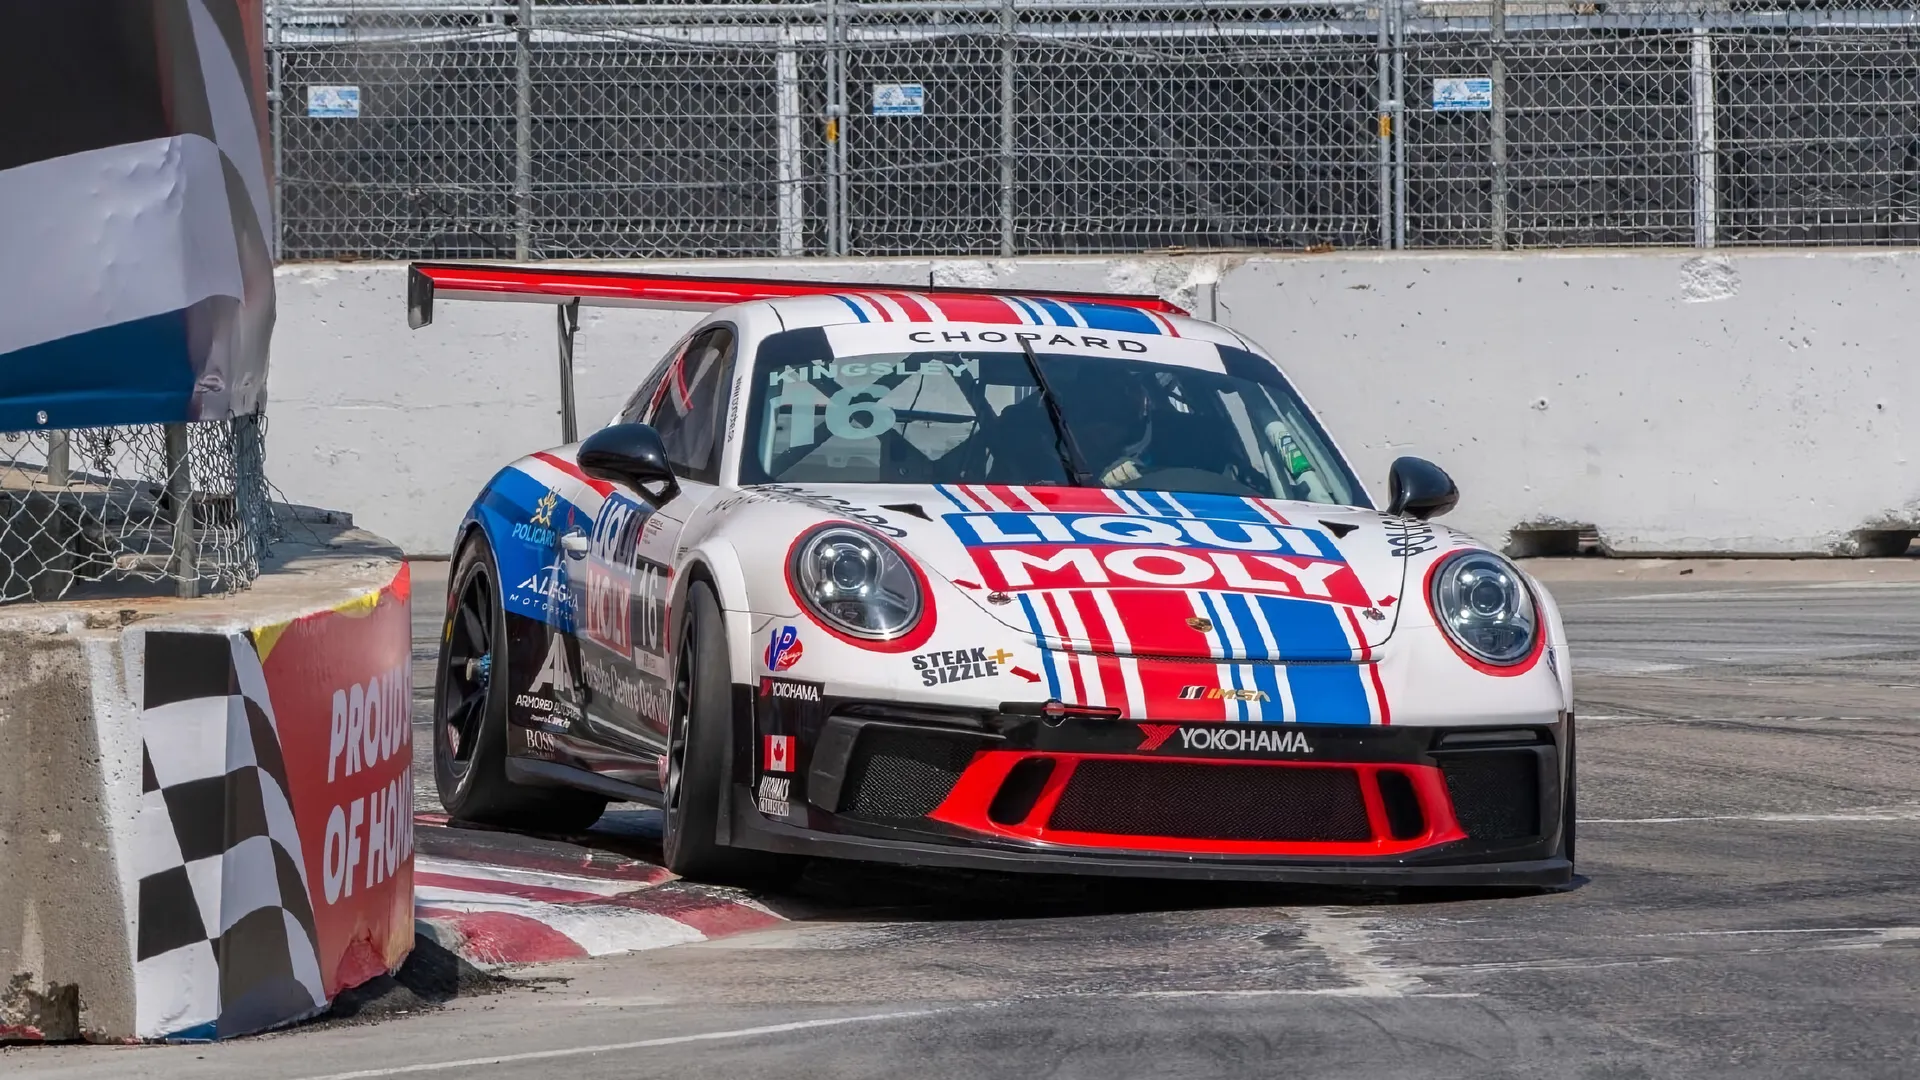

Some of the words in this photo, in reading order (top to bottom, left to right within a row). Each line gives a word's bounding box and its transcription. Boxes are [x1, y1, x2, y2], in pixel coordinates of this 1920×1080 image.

[908, 331, 1149, 354] CHOPARD
[769, 360, 968, 386] KINGSLEY
[769, 384, 897, 448] 16
[511, 522, 556, 548] POLICARO
[590, 498, 642, 576] LIQUI
[963, 514, 1338, 558] LIQUI
[988, 547, 1348, 598] MOLY
[587, 569, 631, 648] MOLY
[639, 562, 659, 650] 16
[911, 646, 988, 671] STEAK
[921, 660, 1000, 687] SIZZLE
[515, 694, 554, 712] ARMORED
[772, 682, 820, 702] YOKOHAMA
[1206, 687, 1272, 703] IMSA
[525, 728, 555, 752] BOSS
[1178, 727, 1314, 753] YOKOHAMA
[323, 797, 365, 906] OF
